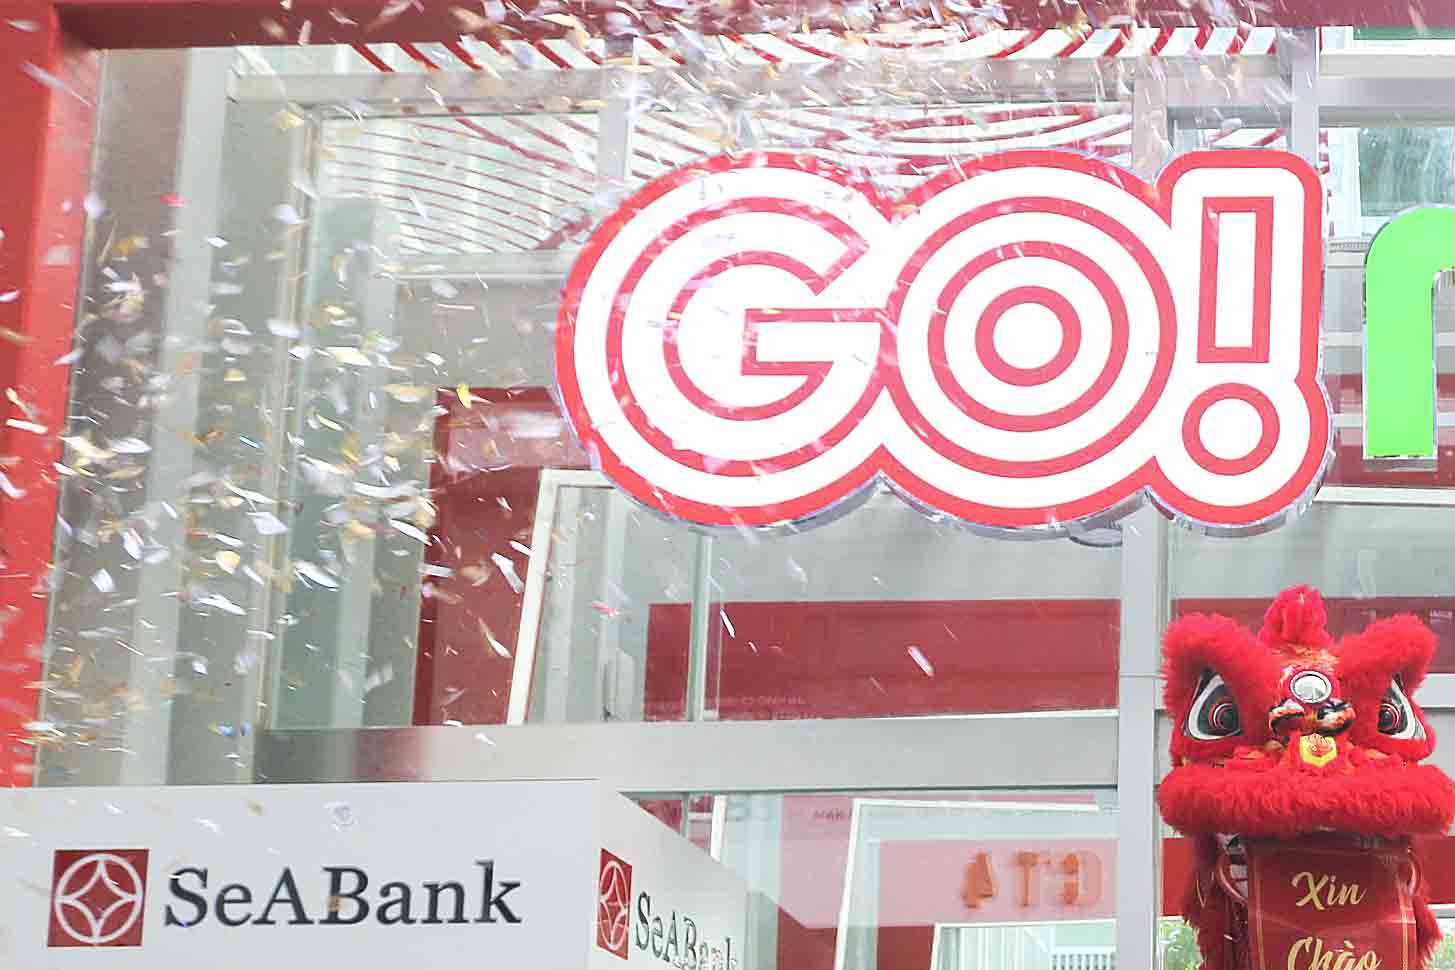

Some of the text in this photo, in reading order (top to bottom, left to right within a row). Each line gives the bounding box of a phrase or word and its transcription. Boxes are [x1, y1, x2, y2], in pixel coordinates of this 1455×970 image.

[556, 150, 1333, 528] GO!
[164, 858, 523, 929] SeABank
[1291, 871, 1367, 911] Xin
